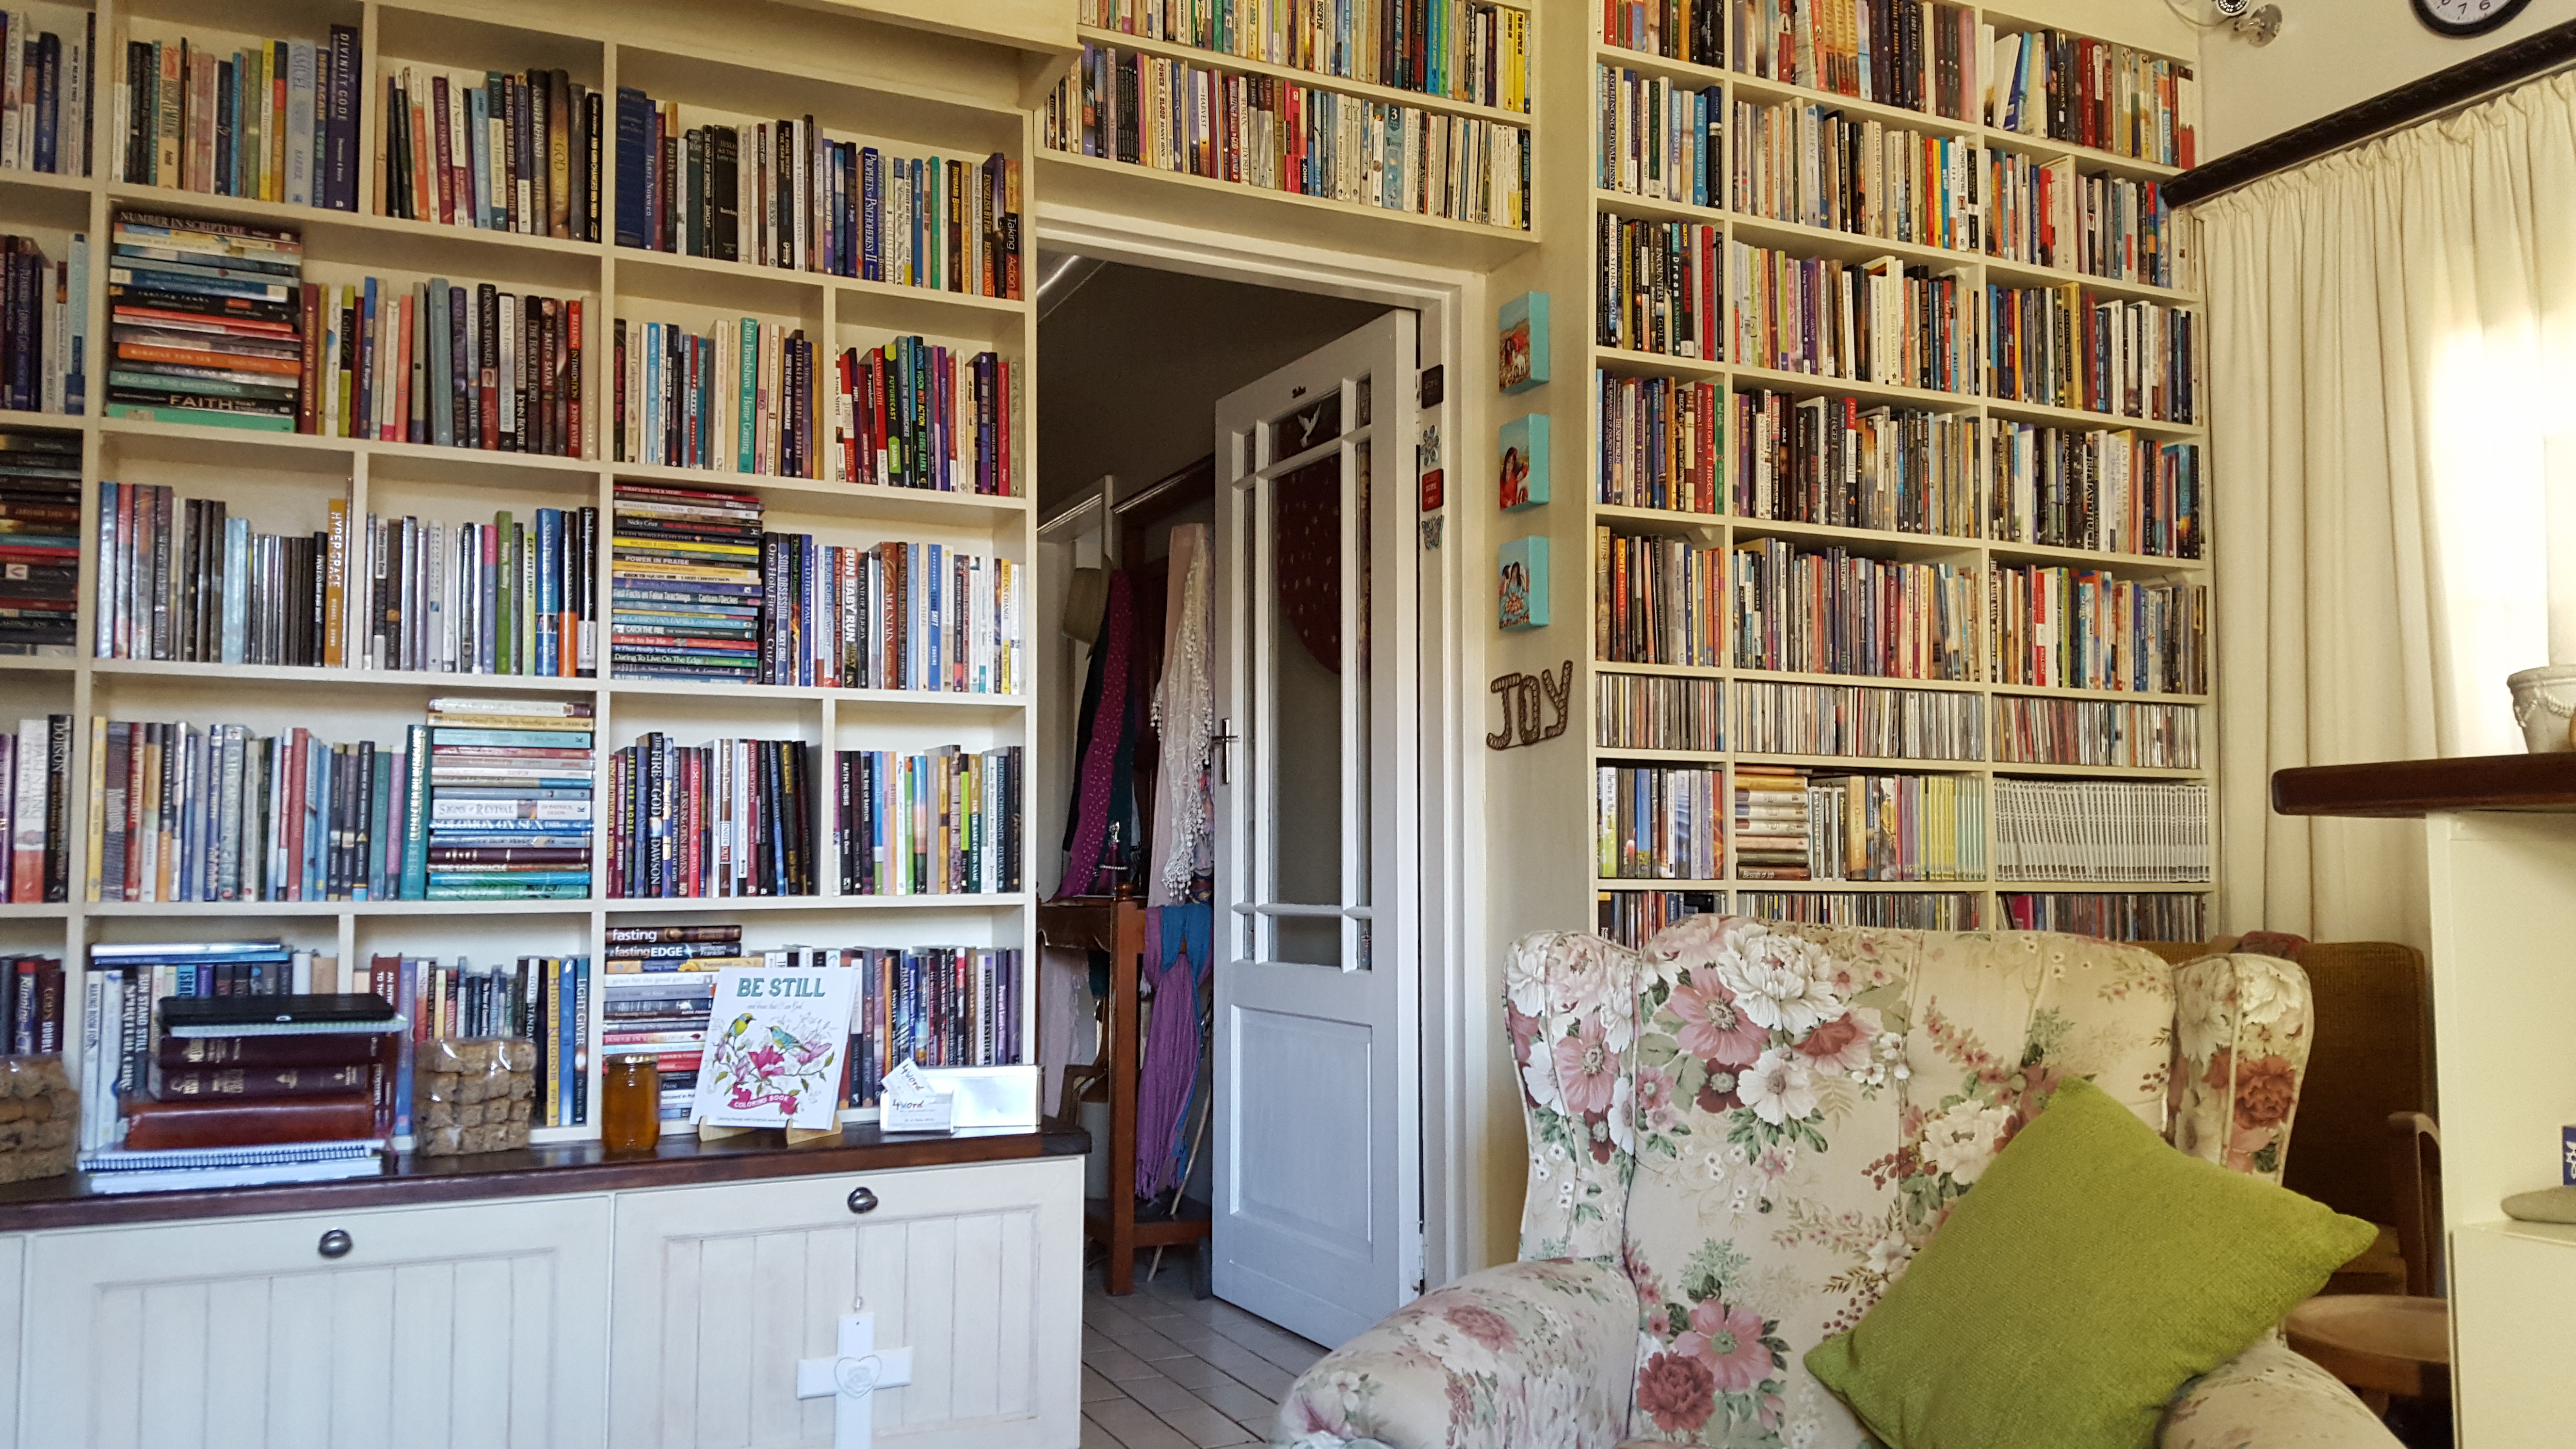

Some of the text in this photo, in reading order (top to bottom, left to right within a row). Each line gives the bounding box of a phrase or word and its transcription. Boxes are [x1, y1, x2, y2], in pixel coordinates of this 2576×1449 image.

[338, 33, 349, 120] DIVINITY CODE
[506, 93, 513, 104] TO
[554, 144, 566, 171] GOD
[706, 164, 710, 173] MY
[865, 153, 877, 191] PROPHETS
[120, 211, 246, 236] NUMBER IN SCRIPTURE
[866, 198, 877, 254] PSYCHOHERESY
[984, 210, 991, 219] BY
[1007, 218, 1016, 288] Taking Action
[530, 355, 537, 365] OF
[570, 350, 580, 398] INTIMIDATION
[741, 320, 754, 454] John Bradshaw Home Coming
[170, 395, 234, 409] FAITH
[516, 395, 525, 416] JOHN
[529, 383, 538, 402] LORD
[517, 418, 525, 446] BEVERE
[328, 512, 342, 588] HYPER-GRACE
[766, 543, 777, 664] One Holy Fire Cruz
[778, 554, 788, 662] SOUL OBSESSION NICKY CRUZ
[845, 549, 855, 642] RUN BABY RUN
[886, 593, 894, 643] MOUNTAIN
[1486, 660, 1574, 752] JOY
[651, 751, 661, 777] FIRE
[721, 745, 730, 775] Kimberly
[440, 805, 514, 815] SIGNS REVIVAL
[650, 789, 661, 815] GOD
[972, 843, 978, 852] OF
[650, 839, 661, 884] DAWSON
[613, 929, 658, 942] fasting
[615, 946, 683, 958] fasting EDGE
[737, 978, 825, 997] BE STILL
[135, 974, 149, 1052] SUN STAND STILL
[734, 1097, 767, 1108] COLORING
